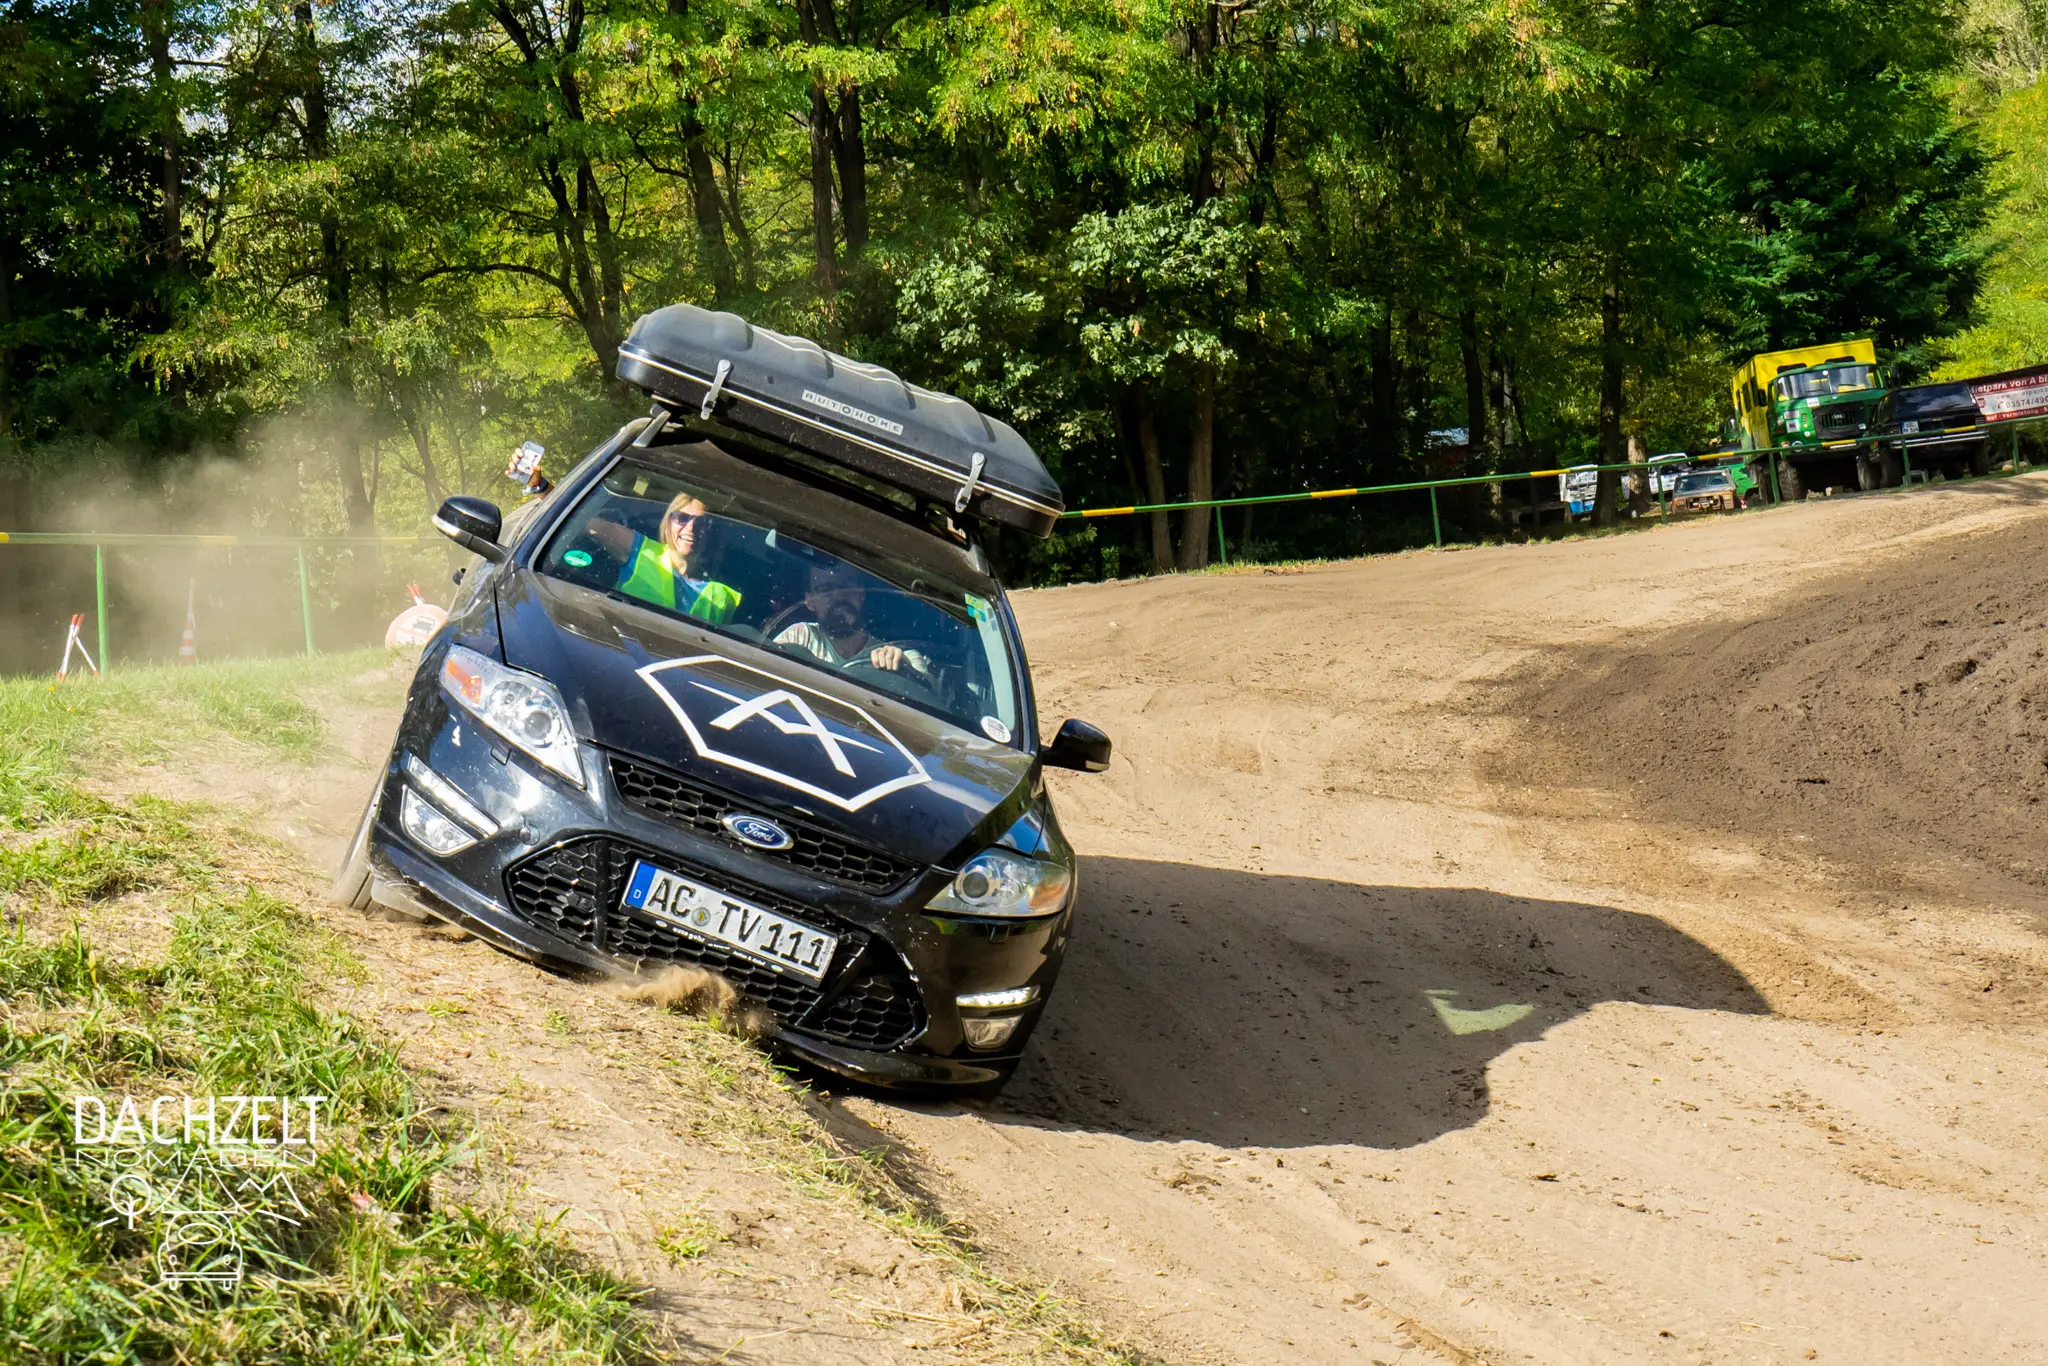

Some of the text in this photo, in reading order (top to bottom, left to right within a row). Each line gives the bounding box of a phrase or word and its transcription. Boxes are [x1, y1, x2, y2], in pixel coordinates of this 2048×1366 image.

[804, 392, 903, 433] AUTOHOME
[744, 822, 780, 842] Ford
[633, 888, 642, 900] D
[647, 876, 697, 919] AC
[717, 900, 762, 943] TV
[760, 922, 826, 972] 111
